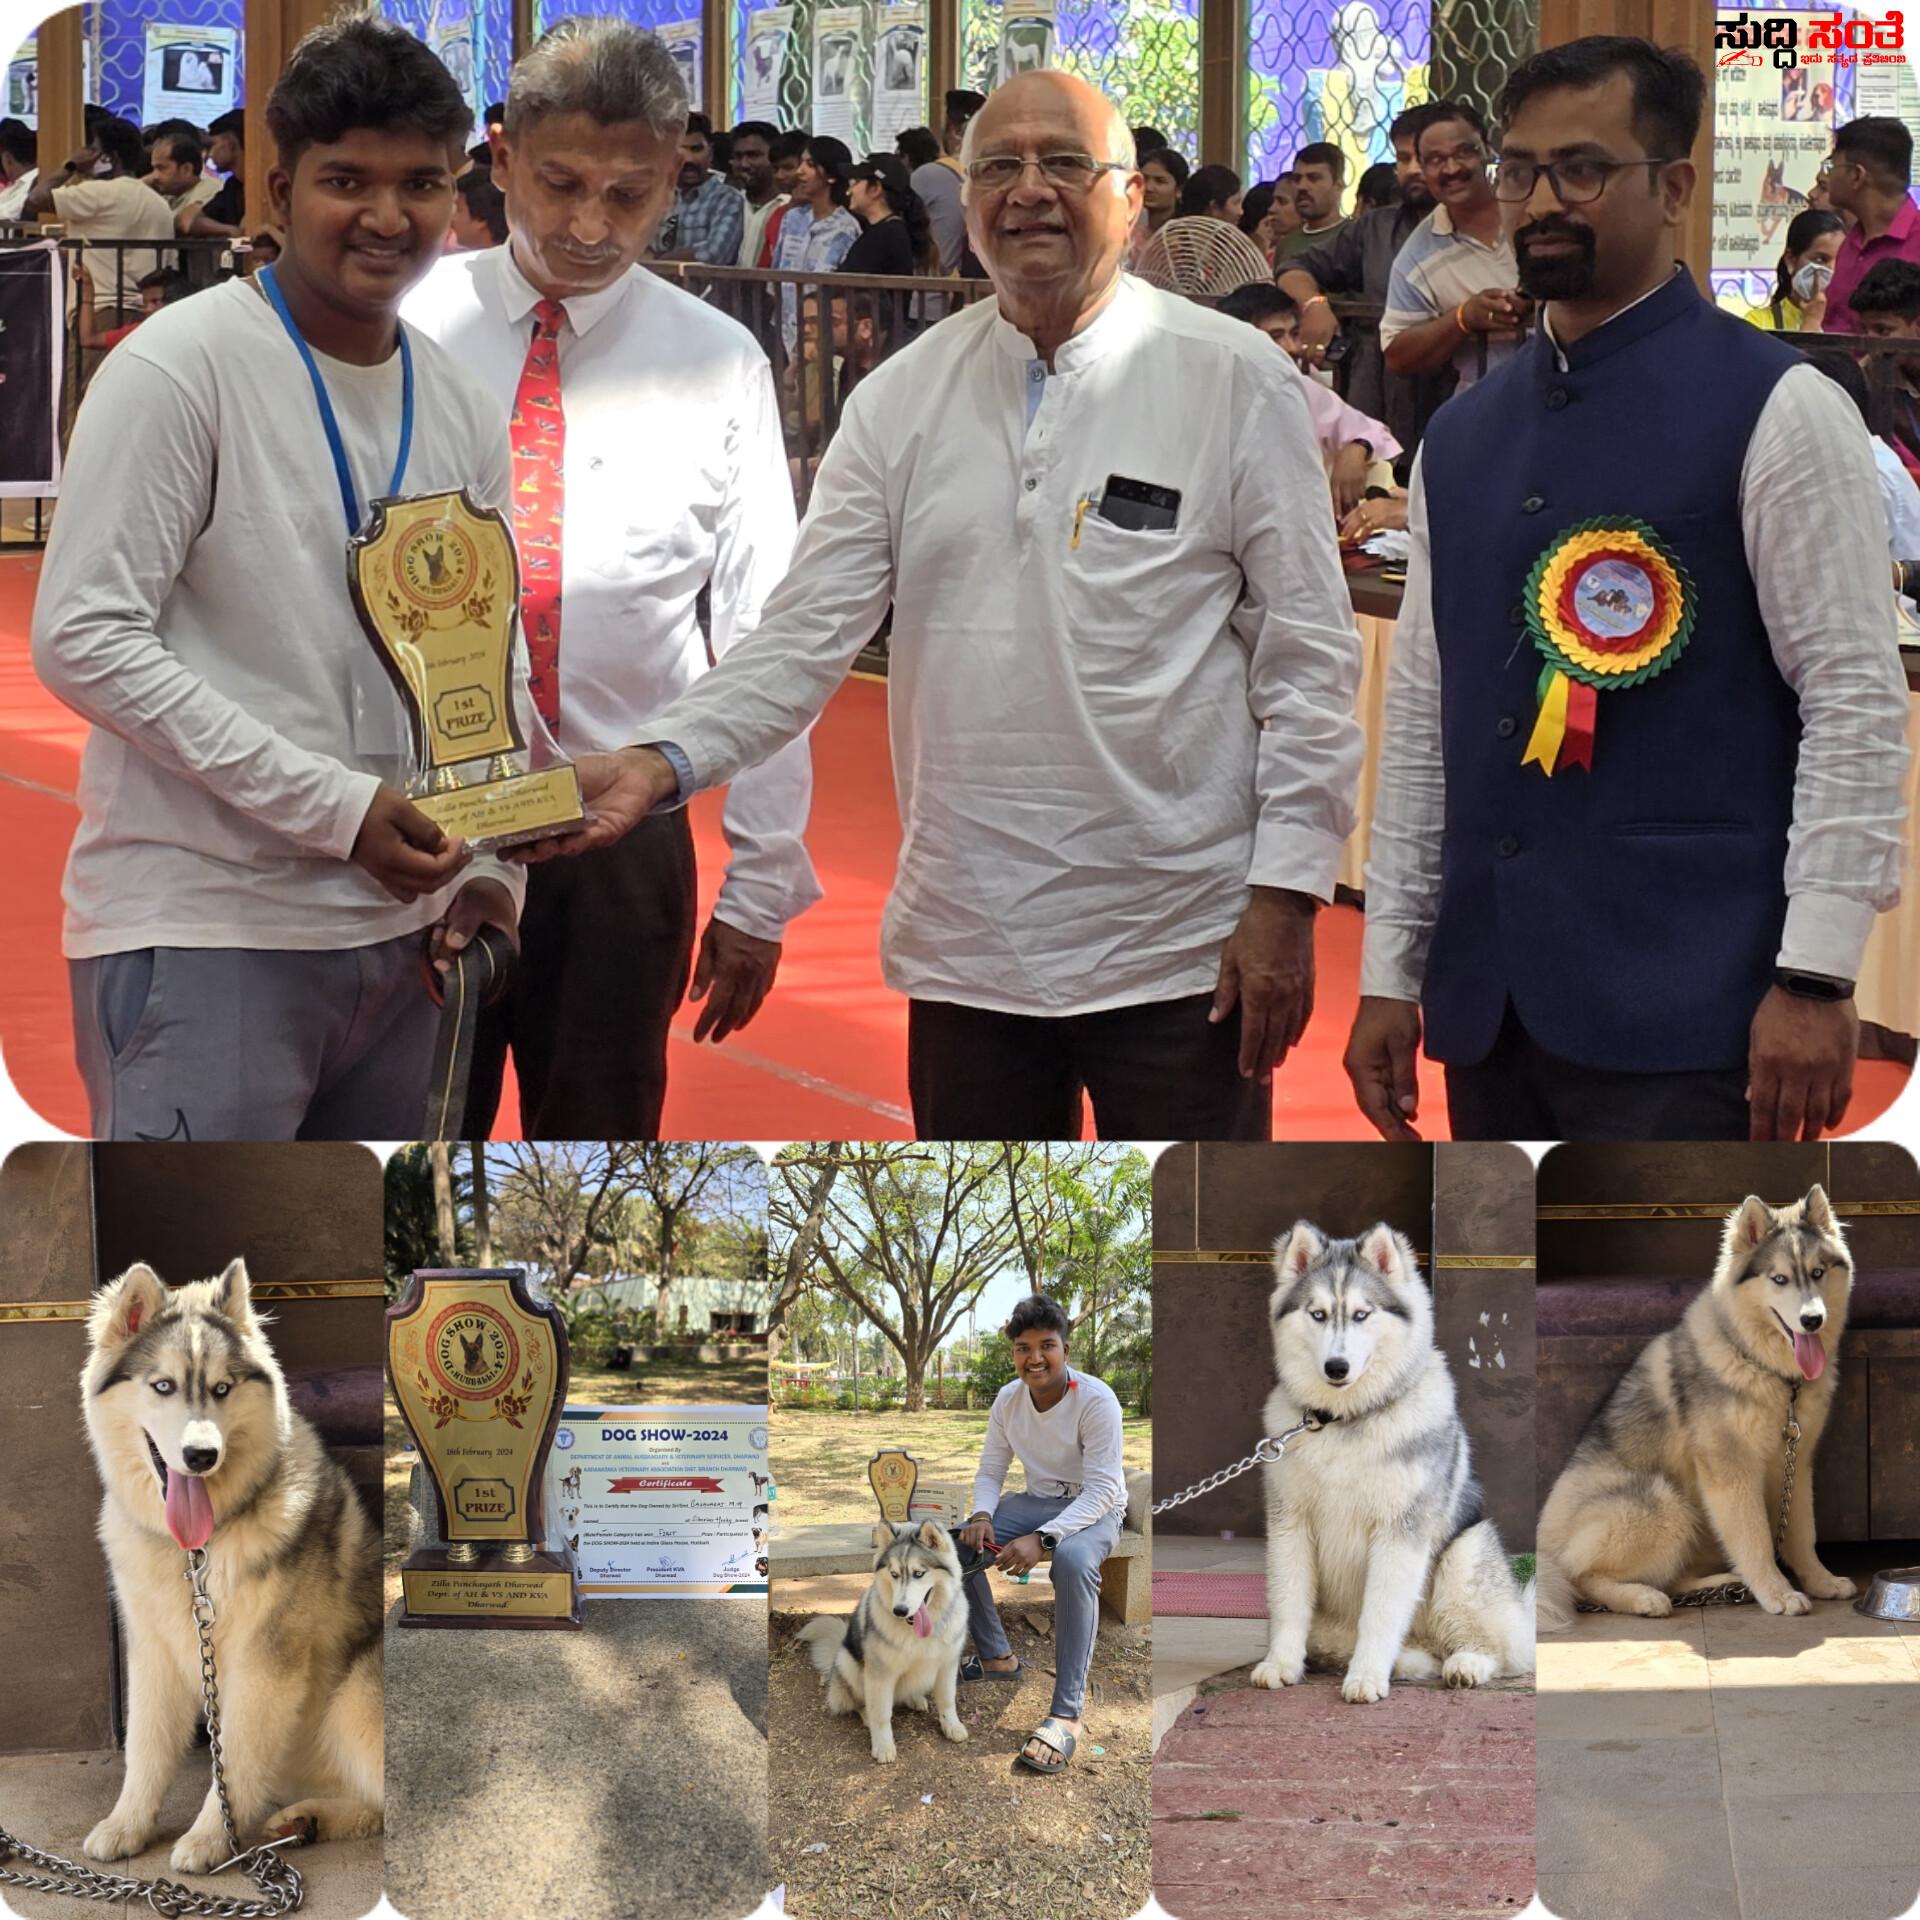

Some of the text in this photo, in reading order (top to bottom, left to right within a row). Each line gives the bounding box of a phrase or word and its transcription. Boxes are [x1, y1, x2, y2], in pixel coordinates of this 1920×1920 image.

[446, 711, 487, 731] PRIZE
[440, 1317, 506, 1372] DOG SHOW 2024
[602, 1429, 729, 1442] DOG SHOW-2024
[462, 1447, 493, 1460] February
[496, 1448, 514, 1456] 2024
[639, 1479, 693, 1488] Certificate
[474, 1488, 497, 1498] 1st
[465, 1503, 506, 1513] PRIZE
[431, 1580, 450, 1588] Zilla
[504, 1581, 545, 1589] Dharwad
